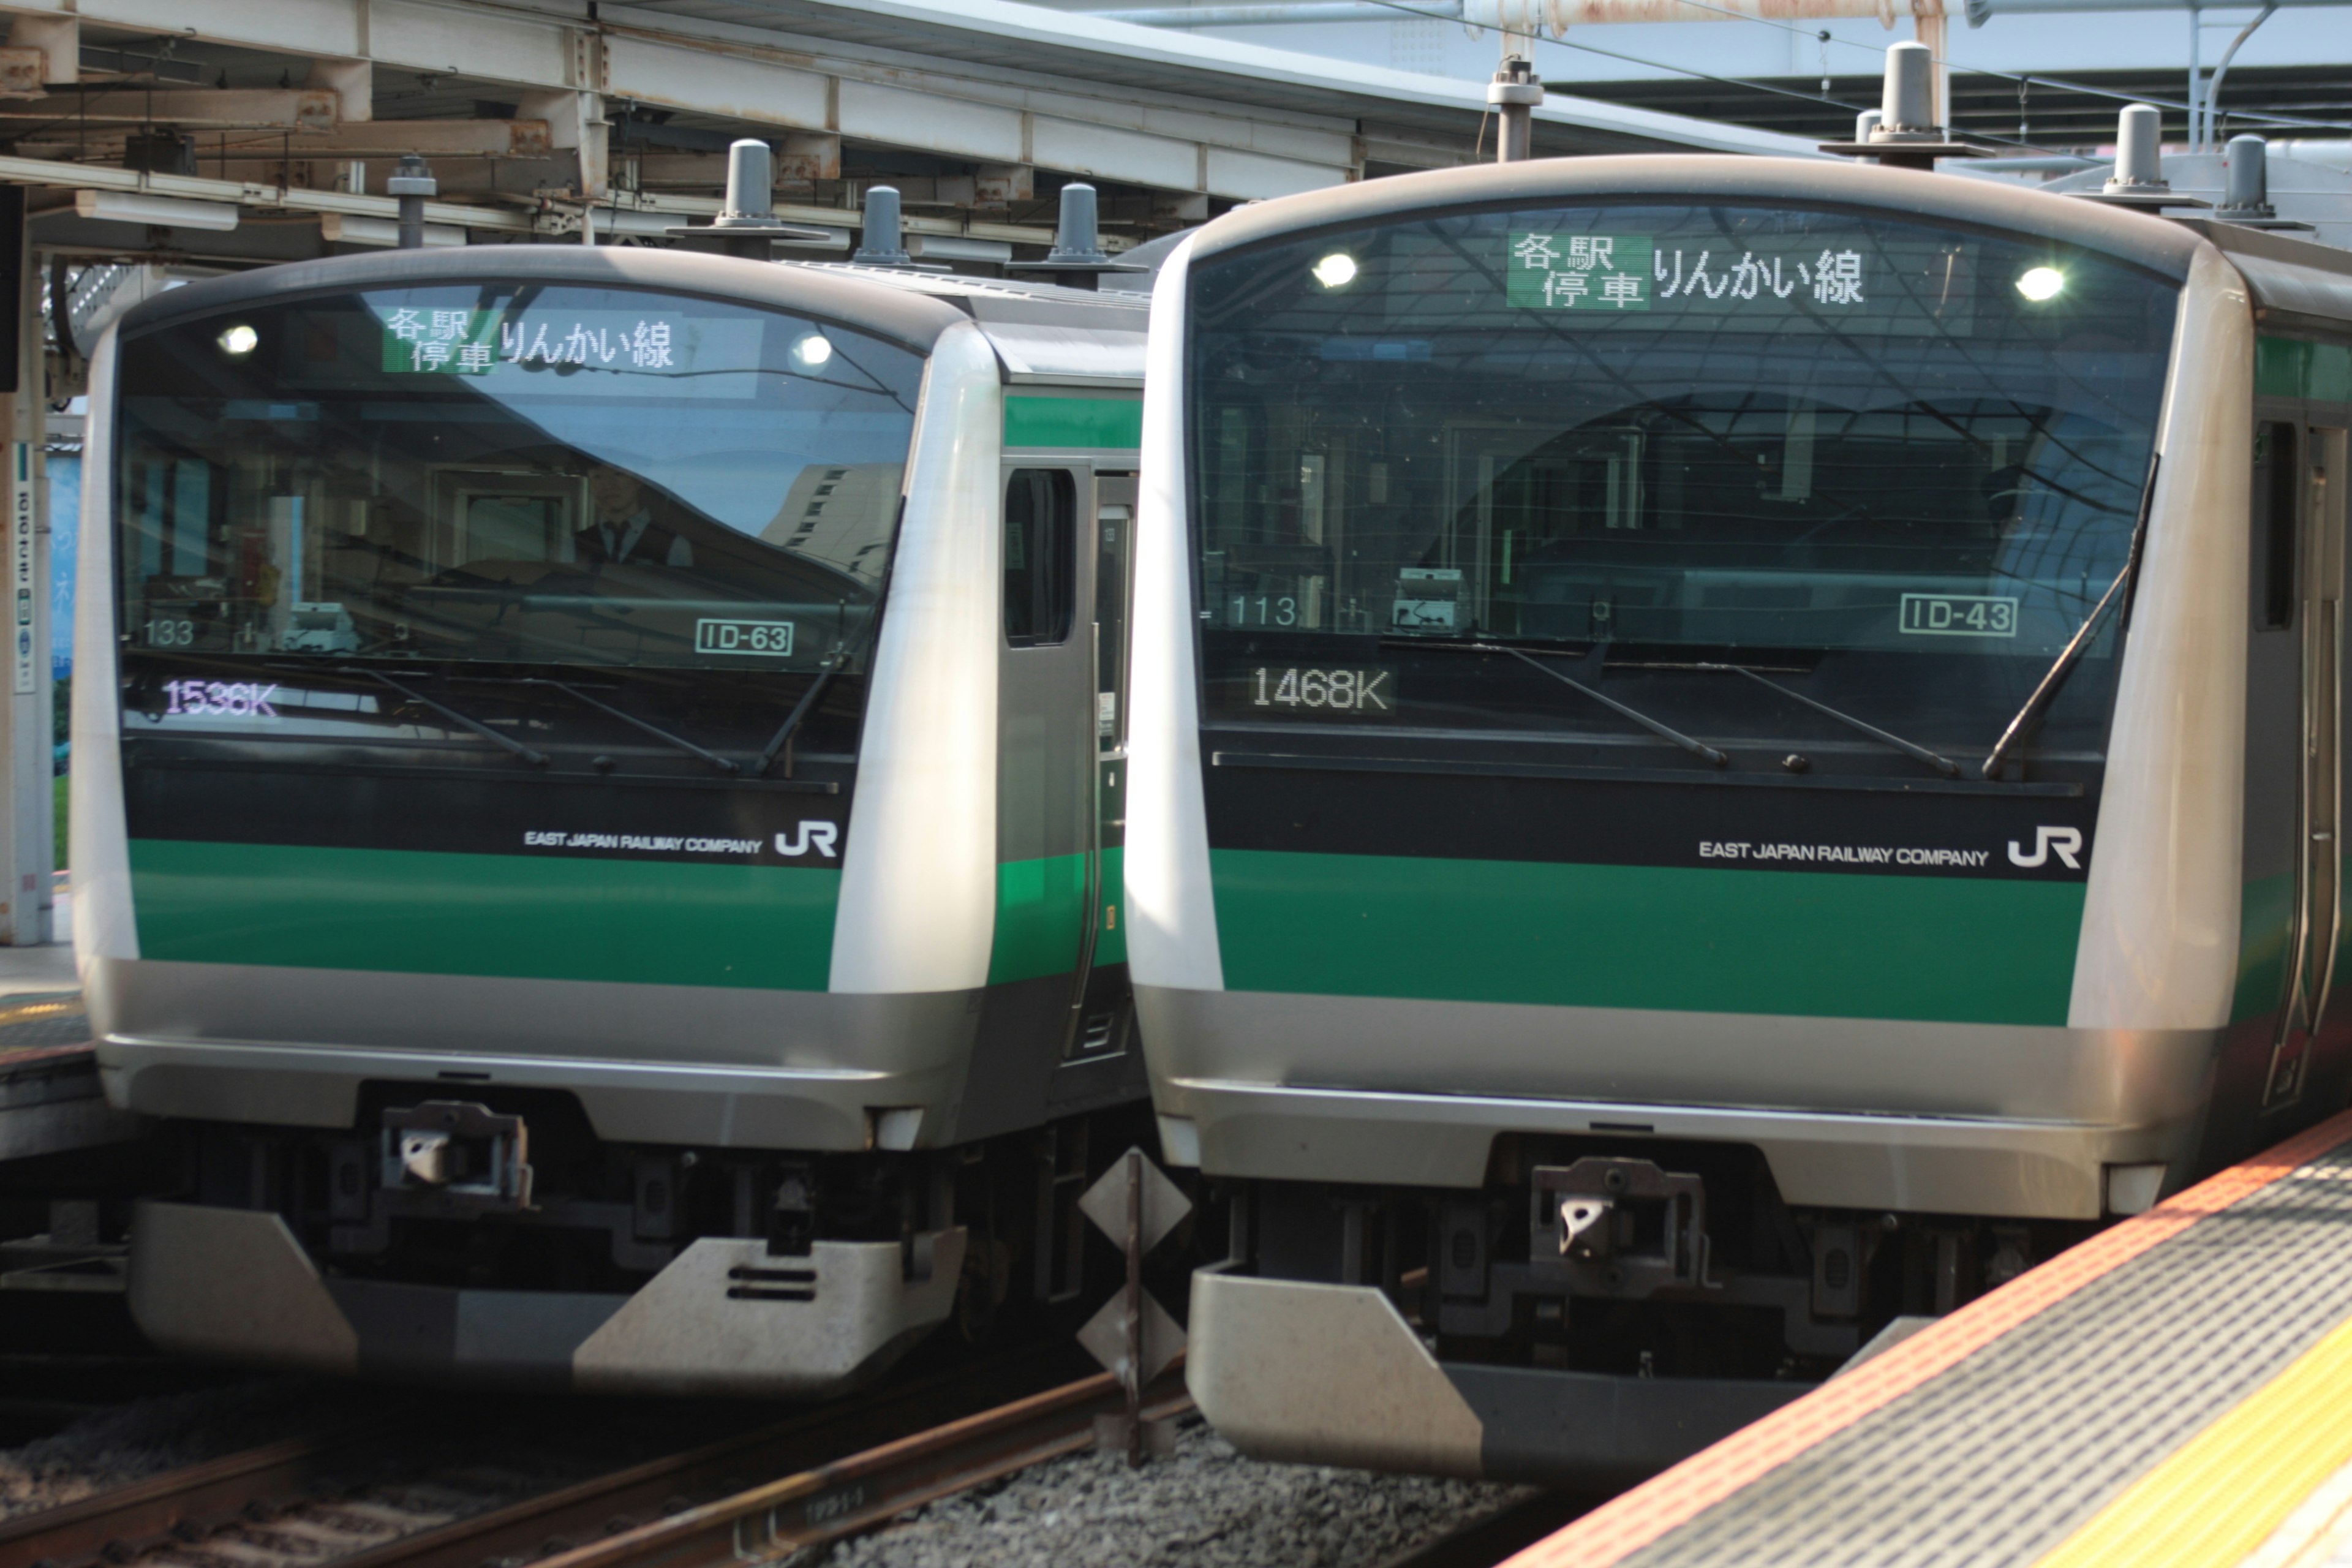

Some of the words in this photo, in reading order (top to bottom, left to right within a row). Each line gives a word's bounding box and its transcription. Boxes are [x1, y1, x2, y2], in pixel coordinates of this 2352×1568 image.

[1514, 233, 1613, 271] 各駅
[1542, 270, 1644, 307] 停車
[1654, 249, 1864, 304] りんかい線
[388, 308, 468, 340] 各駅
[411, 341, 495, 372] 停車
[502, 320, 674, 368] りんかい線
[1233, 595, 1296, 626] 113
[144, 619, 194, 646] 133
[166, 679, 278, 717] 1536K
[1254, 667, 1389, 710] 1468K
[524, 831, 567, 846] EAST
[567, 834, 618, 849] JAPAN
[620, 835, 685, 851] RAILWAY
[685, 837, 763, 854] COMPANY
[775, 820, 838, 858] JR
[1699, 841, 1752, 858] EAST
[1752, 843, 1815, 861] JAPAN
[1817, 845, 1893, 864] RAILWAY
[1896, 848, 1989, 867] COMPANY
[2007, 826, 2082, 869] JR
